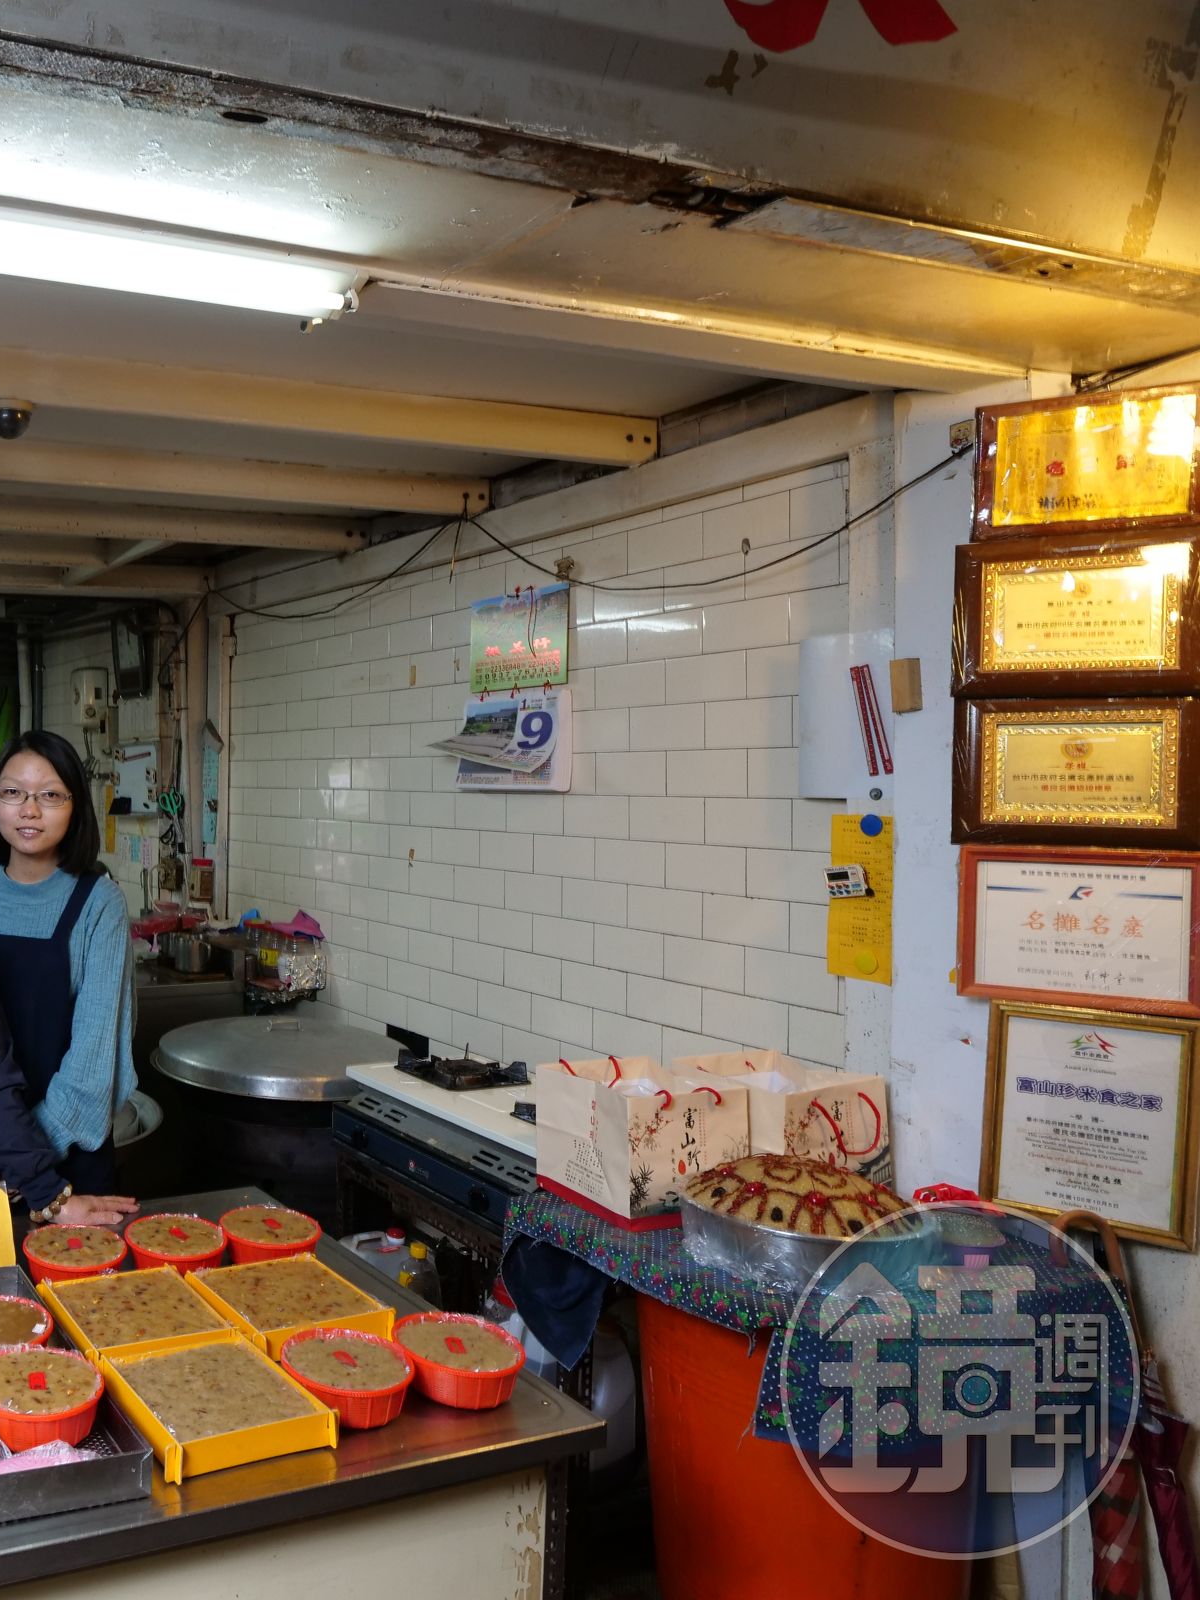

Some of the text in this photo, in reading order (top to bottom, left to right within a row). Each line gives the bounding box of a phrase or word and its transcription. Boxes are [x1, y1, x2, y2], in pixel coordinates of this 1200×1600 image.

[517, 711, 553, 750] 9
[1020, 910, 1144, 938] 名攤名產
[1016, 1077, 1162, 1112] 富山珍米食之家
[681, 1107, 701, 1172] 富山珍
